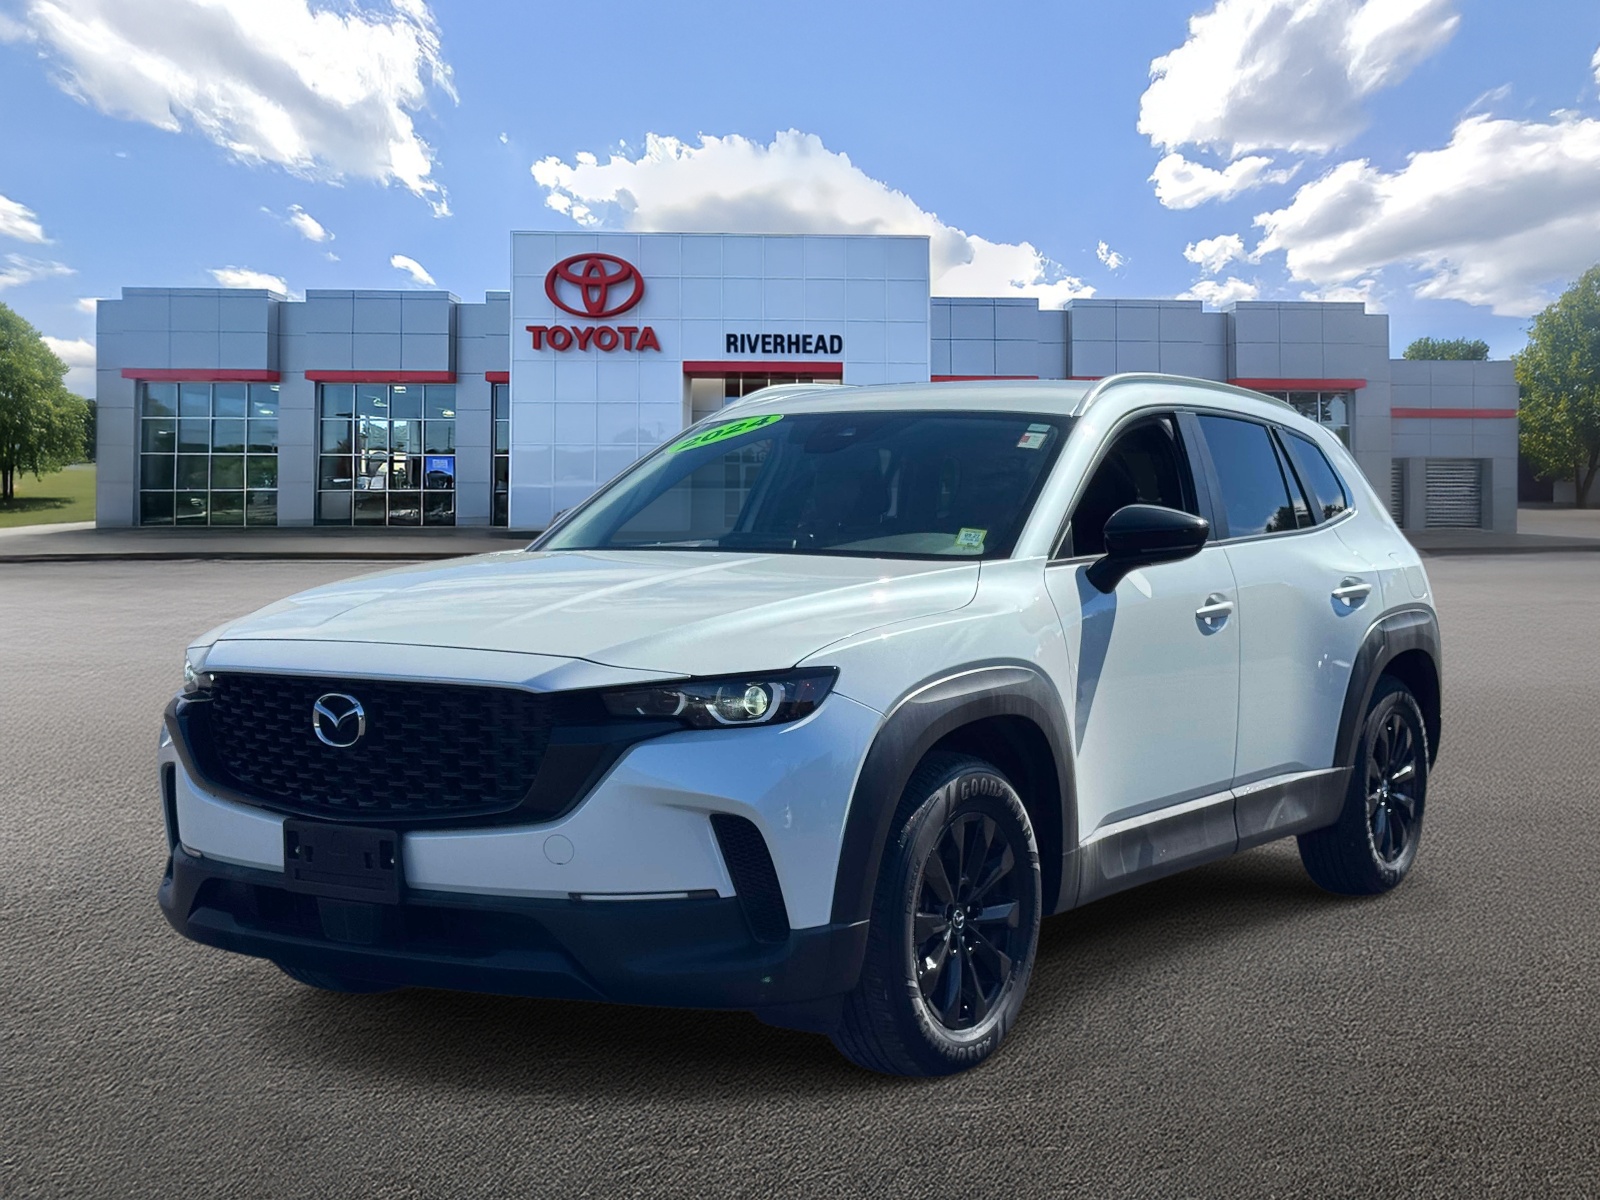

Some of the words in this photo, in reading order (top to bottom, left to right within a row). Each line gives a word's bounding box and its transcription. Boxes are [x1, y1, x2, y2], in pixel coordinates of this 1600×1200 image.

[526, 325, 661, 352] TOYOTA
[726, 333, 843, 354] RIVERHEAD
[676, 415, 774, 451] 2024
